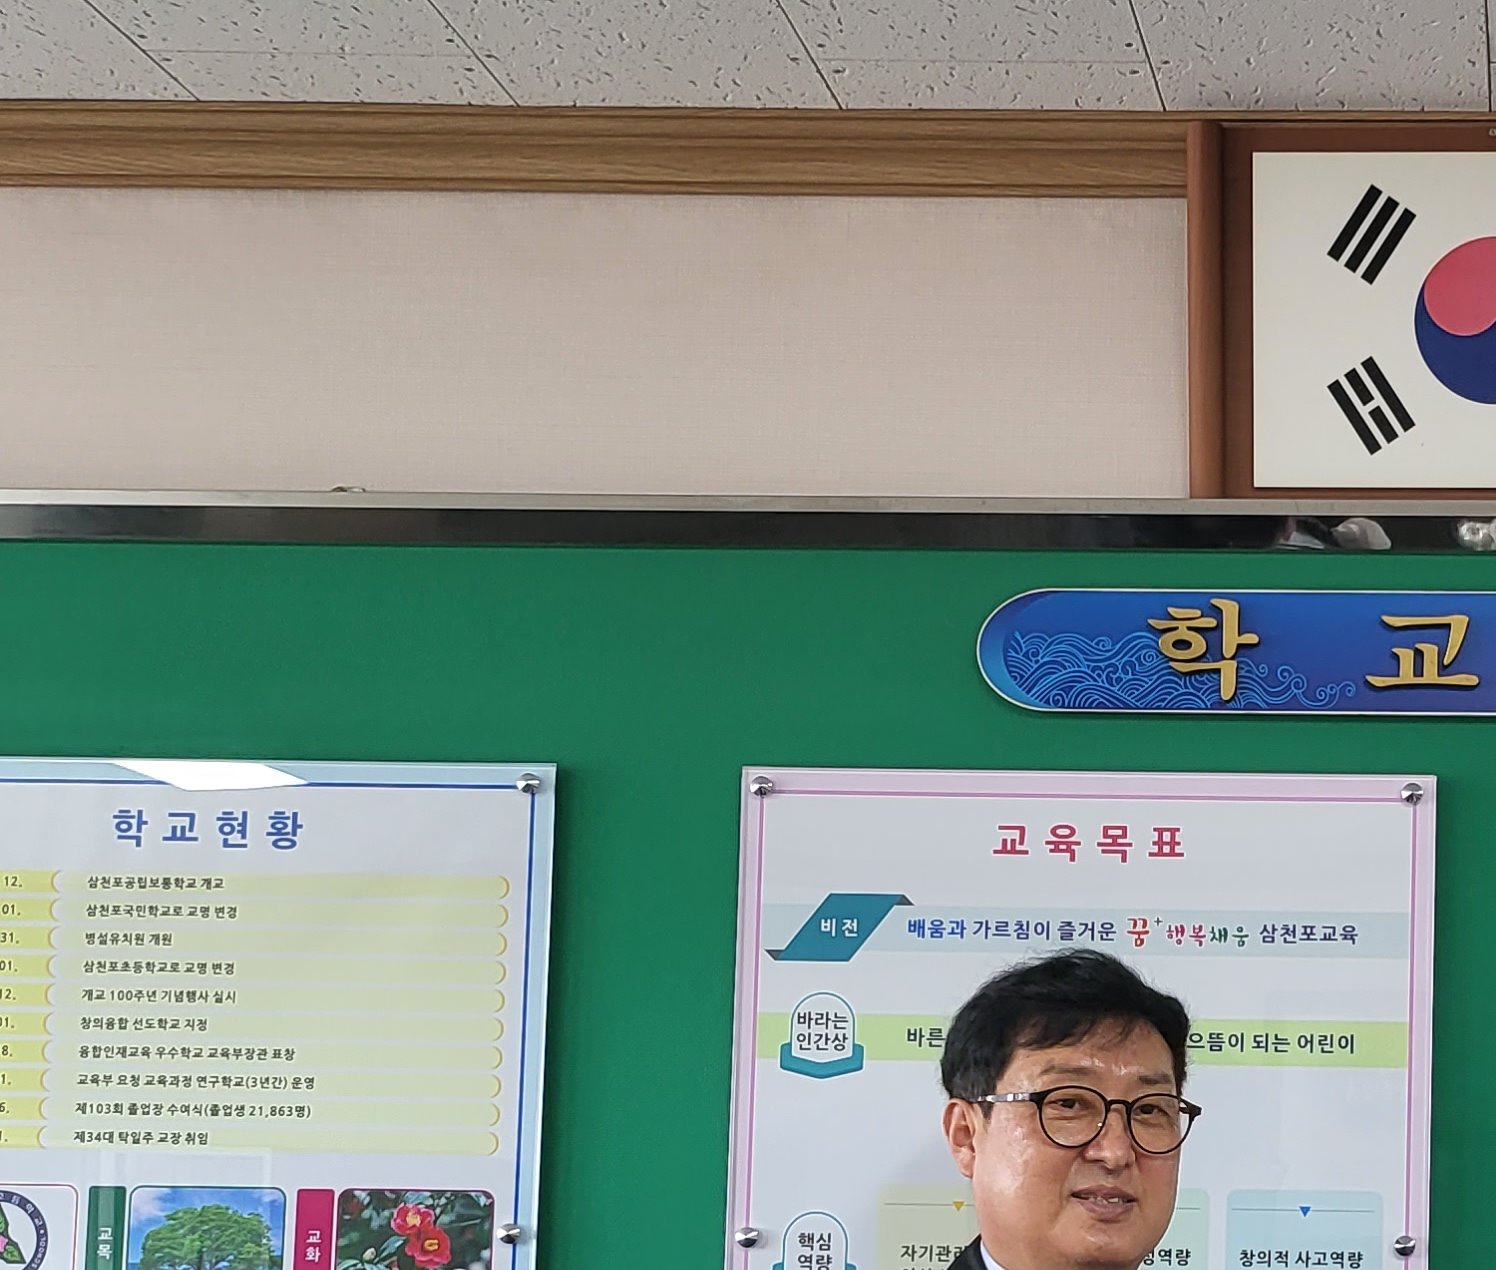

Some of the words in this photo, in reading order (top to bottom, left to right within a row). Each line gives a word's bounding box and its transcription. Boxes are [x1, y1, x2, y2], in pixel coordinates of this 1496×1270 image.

[113, 810, 303, 850] 학교현황
[992, 825, 1185, 862] 교육목표
[88, 877, 197, 890] 삼천포공립보통학교
[201, 878, 224, 890] 개교
[86, 905, 184, 917] 삼천포국민학교로
[187, 906, 209, 918] 교명
[215, 906, 237, 919] 변경
[820, 919, 858, 938] 비전
[907, 920, 967, 940] 배움과
[973, 920, 1051, 942] 가르침이
[1057, 922, 1116, 943] 즐거운
[1259, 924, 1358, 945] 삼천포교육
[85, 933, 144, 946] 병설유치원
[149, 933, 172, 946] 개원
[83, 961, 180, 974] 삼천포초등학교로
[184, 962, 207, 974] 교명
[212, 962, 234, 975] 변경
[81, 989, 105, 1001] 개교
[110, 990, 157, 1002] 100주년
[161, 991, 209, 1004] 기념행사
[213, 991, 236, 1004] 실시
[133, 1018, 180, 1030] 선도학교
[184, 1019, 208, 1031] 지정
[797, 1011, 849, 1030] 바라는
[796, 1032, 849, 1051] 인간상
[1252, 1034, 1290, 1053] 되는
[1298, 1034, 1354, 1054] 어린이
[155, 1046, 203, 1060] 우수학교
[207, 1047, 267, 1061] 교육부장관
[272, 1048, 295, 1061] 표창
[77, 1074, 113, 1087] 교육부
[117, 1075, 140, 1087] 요청
[144, 1075, 192, 1088] 교육과정
[291, 1077, 315, 1090] 운영
[75, 1103, 123, 1115] 제103회
[74, 1131, 114, 1143] 제34대
[119, 1131, 154, 1144] 탁일주
[158, 1132, 181, 1144] 교장
[185, 1133, 208, 1145] 취임
[798, 1232, 832, 1251] 핵심
[1239, 1250, 1290, 1269] 창의적
[1295, 1251, 1363, 1270] 사고역량
